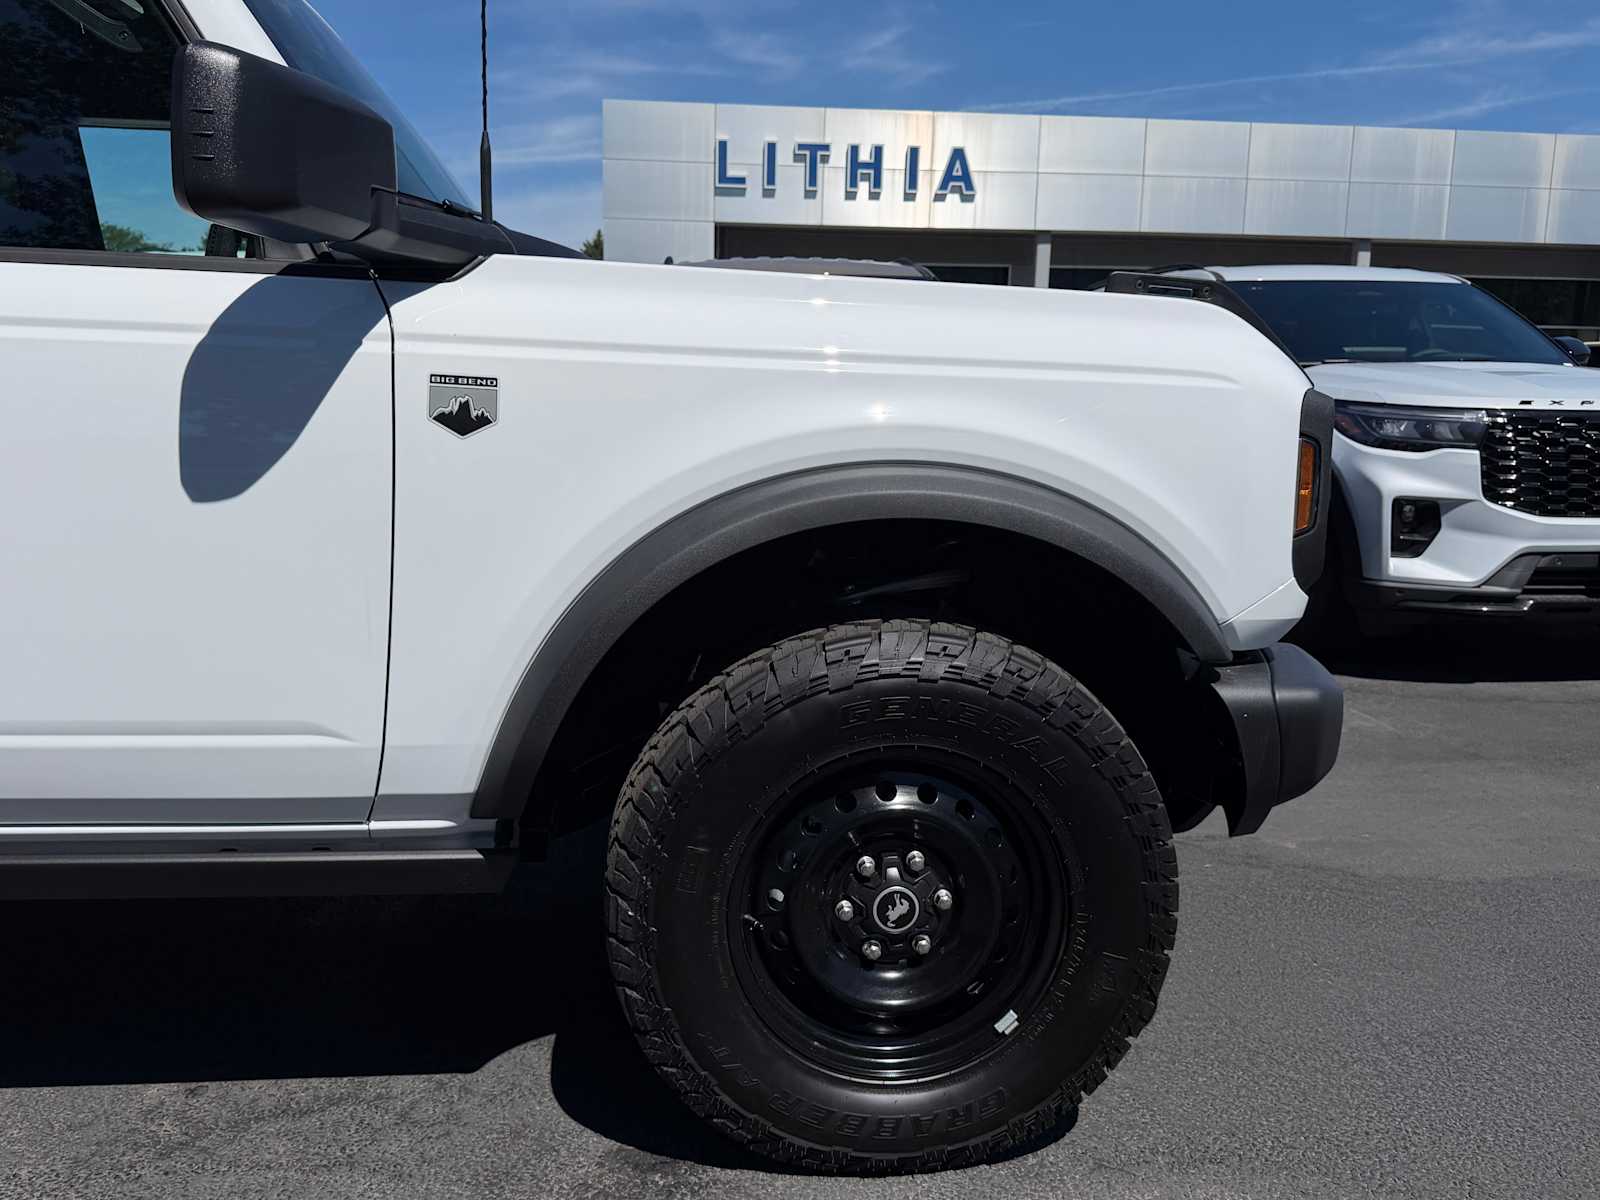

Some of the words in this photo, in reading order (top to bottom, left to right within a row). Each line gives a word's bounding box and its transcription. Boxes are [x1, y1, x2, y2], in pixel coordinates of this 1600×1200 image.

[715, 137, 976, 196] LITHIA
[430, 375, 456, 384] BIG
[458, 377, 497, 386] BEND
[840, 695, 1071, 788] GENERAL
[767, 1085, 1010, 1141] GRABBER
